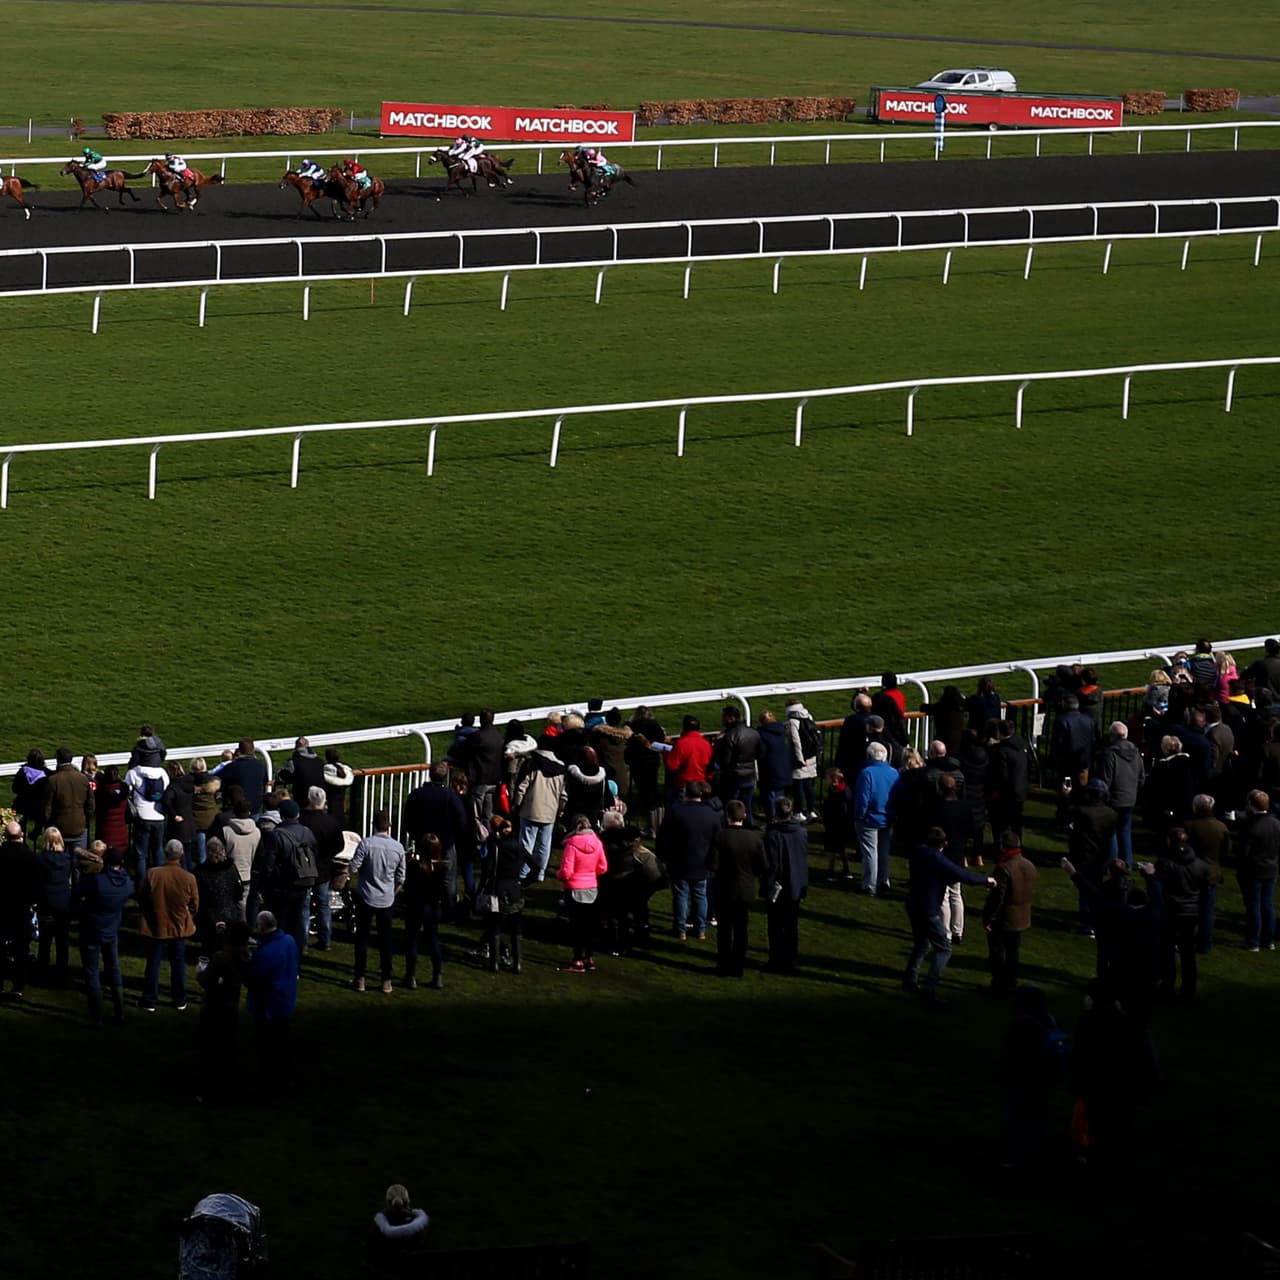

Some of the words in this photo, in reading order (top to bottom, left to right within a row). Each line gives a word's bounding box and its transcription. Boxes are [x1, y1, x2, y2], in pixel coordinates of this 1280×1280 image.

[1030, 107, 1113, 120] MATCHBOOK
[389, 111, 492, 130] MATCHBOOK
[515, 117, 618, 135] MATCHBOOK
